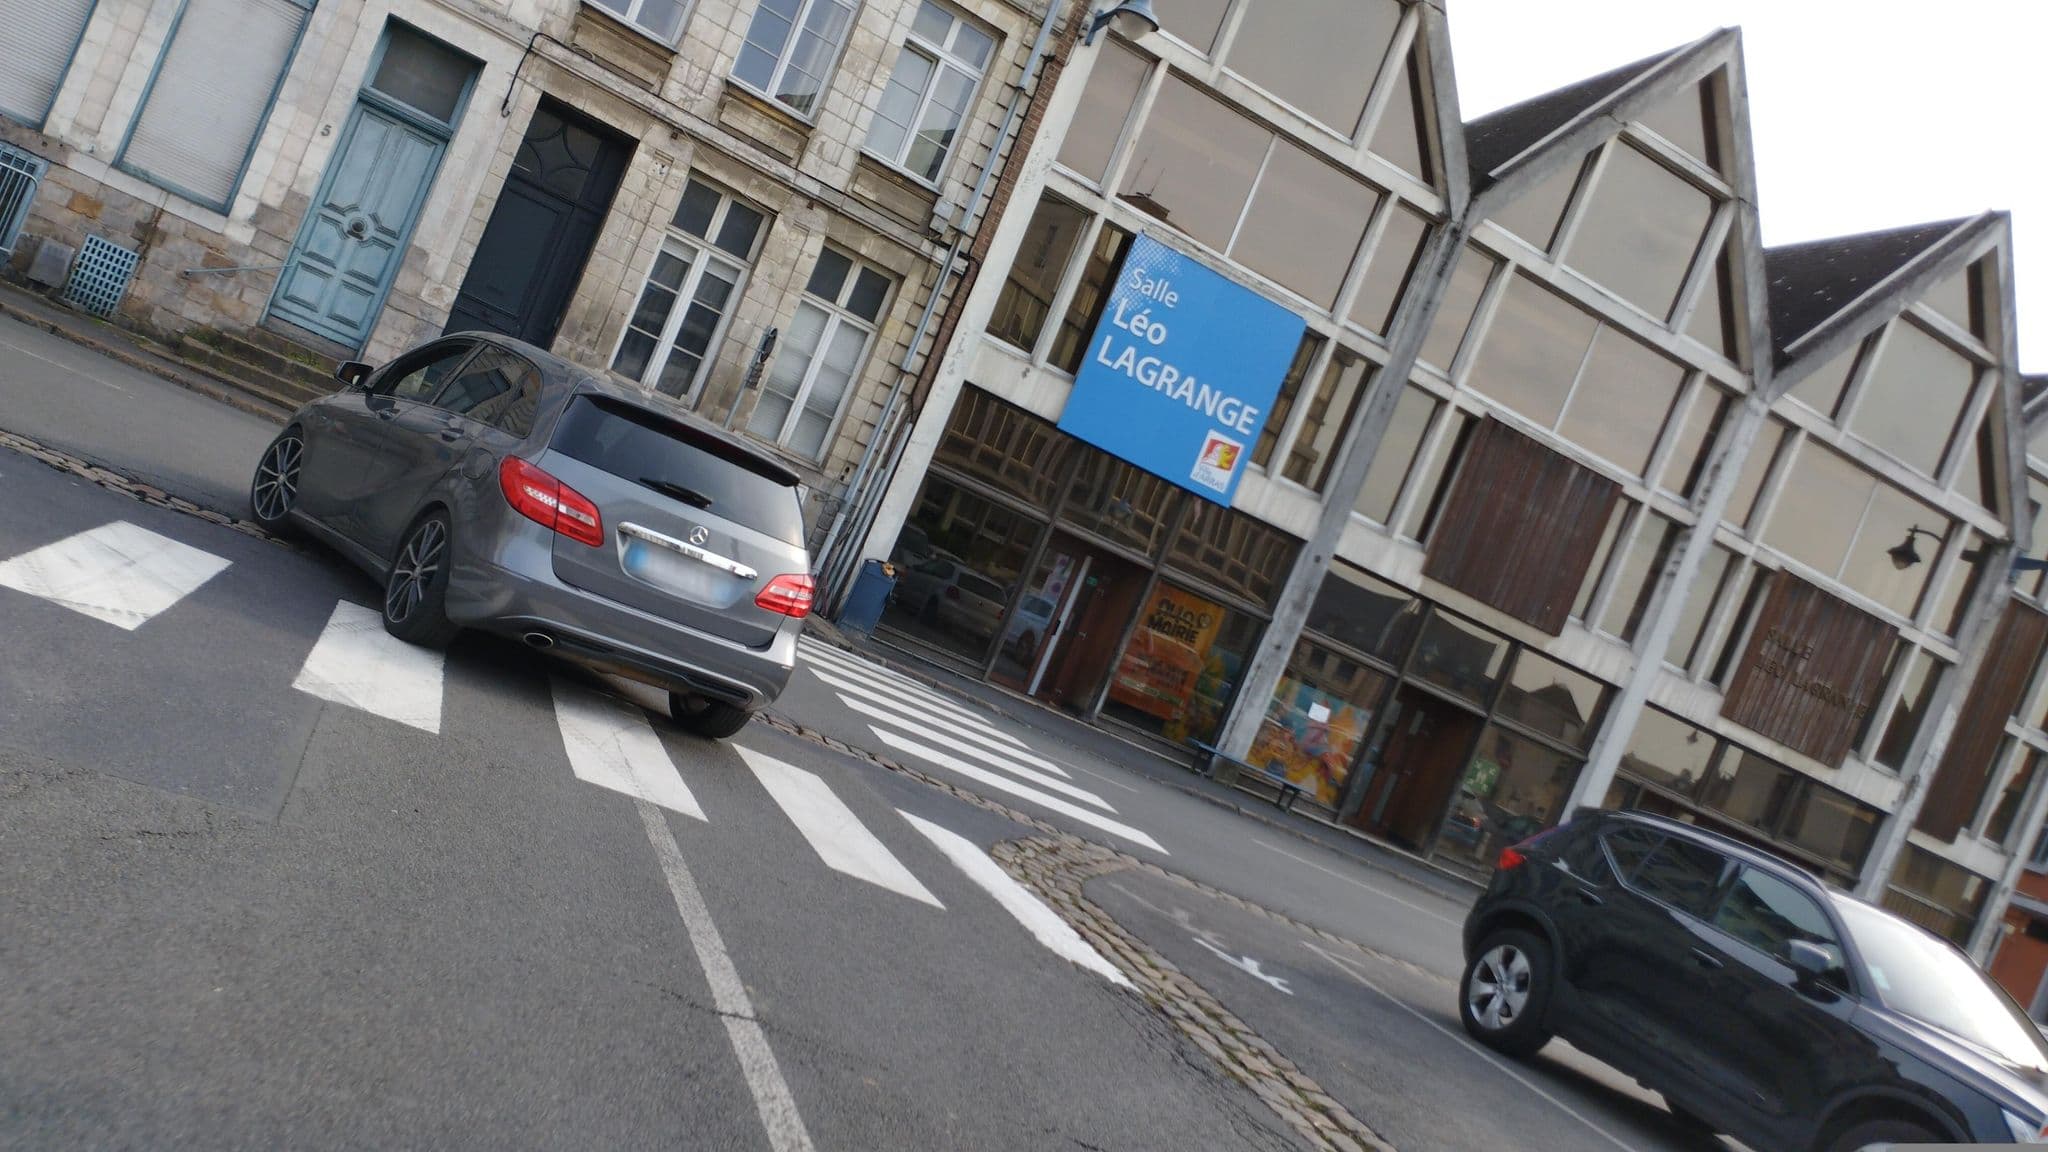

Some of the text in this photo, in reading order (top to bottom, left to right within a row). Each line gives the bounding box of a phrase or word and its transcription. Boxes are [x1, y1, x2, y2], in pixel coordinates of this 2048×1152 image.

[320, 124, 332, 136] 5
[1130, 268, 1179, 308] Salle
[1113, 297, 1167, 345] Léo
[1096, 335, 1259, 435] LAGRANGE
